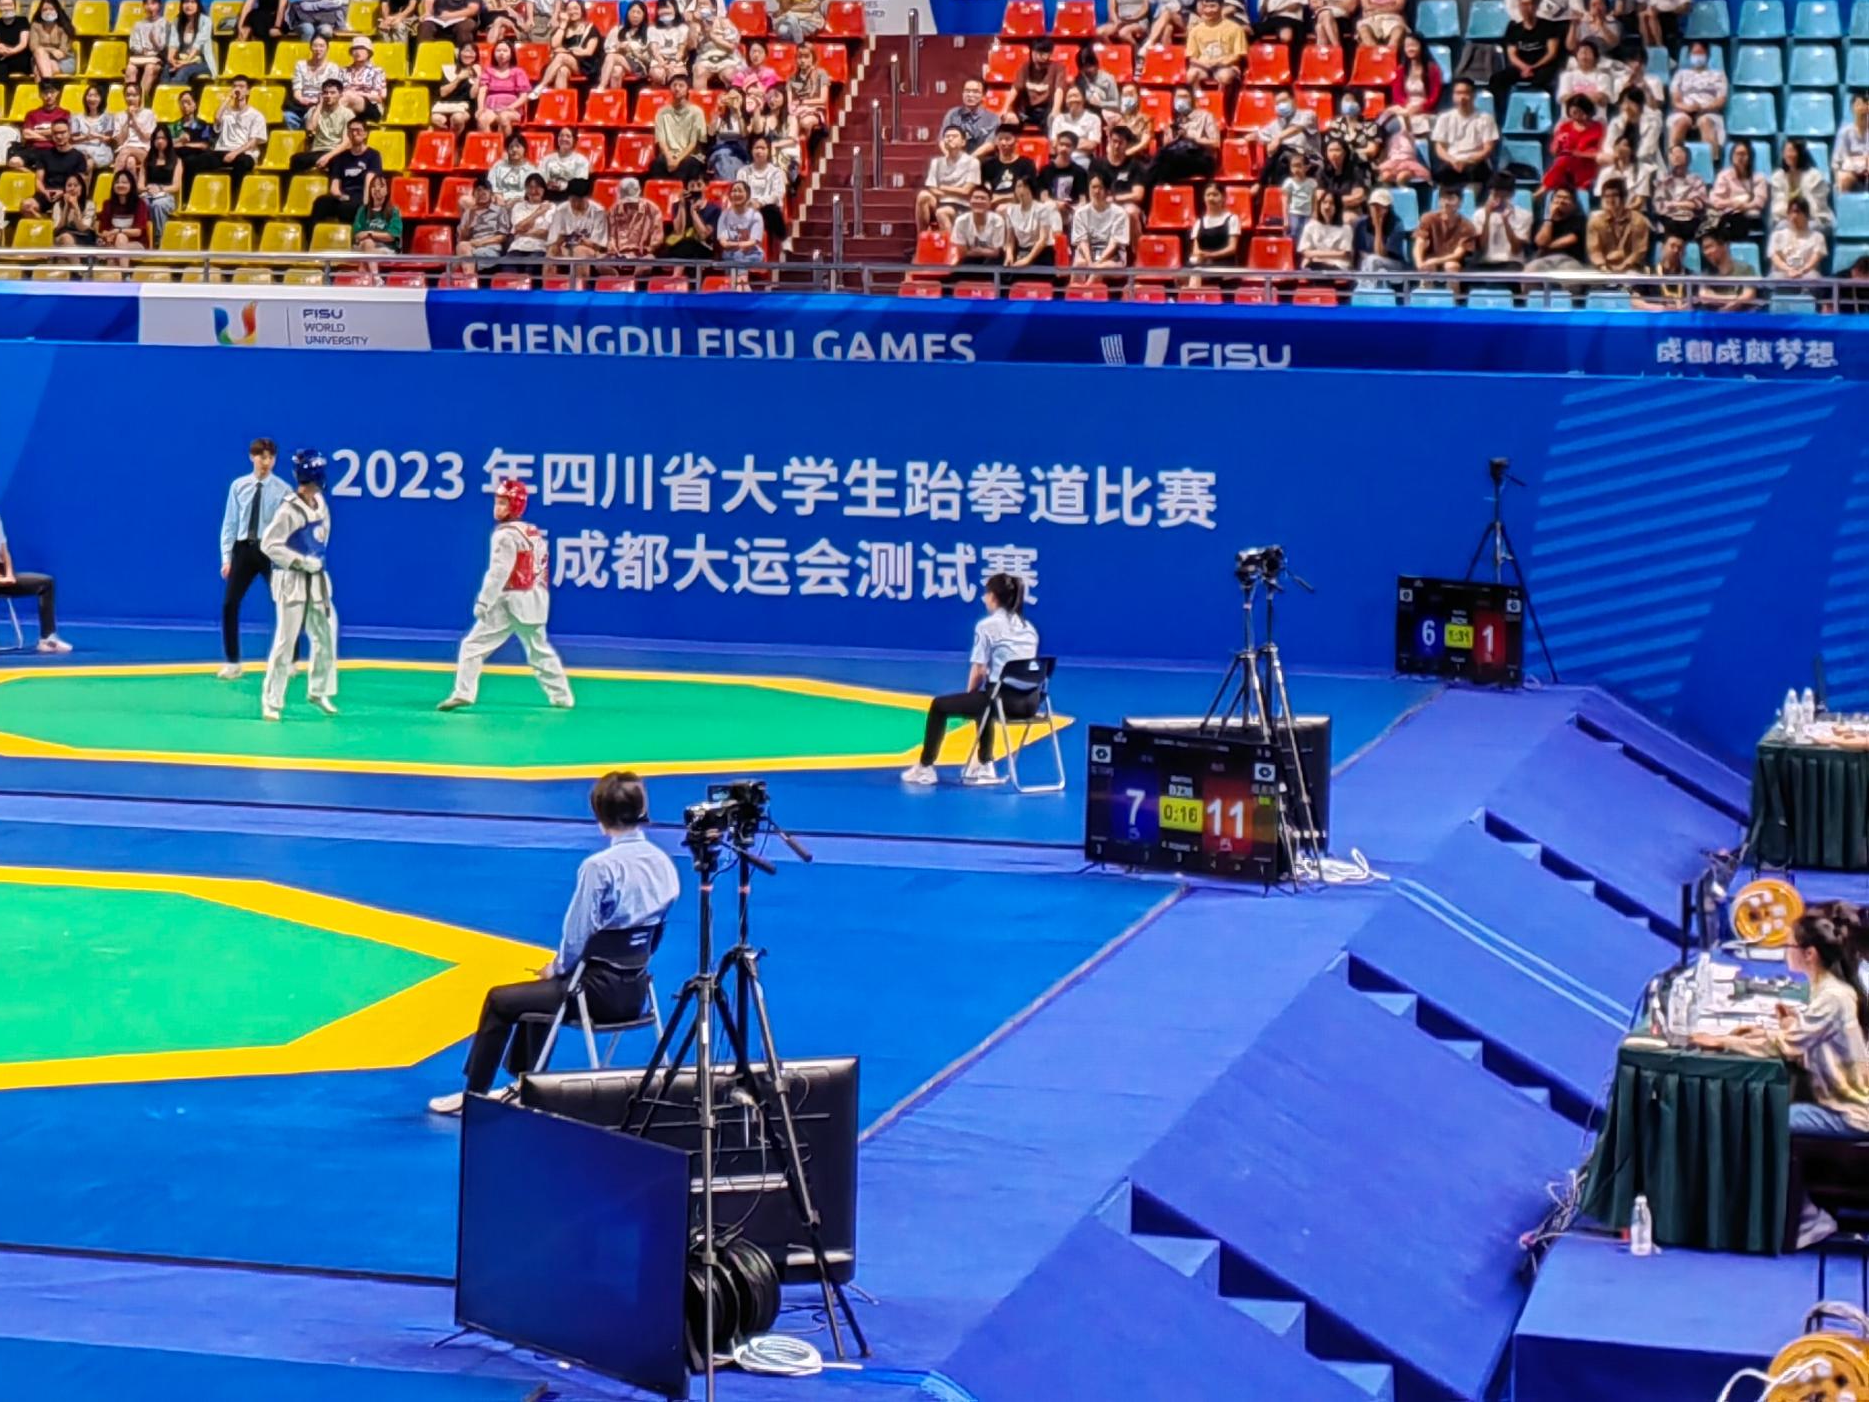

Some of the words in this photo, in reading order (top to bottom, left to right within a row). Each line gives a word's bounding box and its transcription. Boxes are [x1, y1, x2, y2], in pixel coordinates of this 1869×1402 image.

[303, 309, 343, 319] FISU
[304, 322, 345, 333] WORLD
[305, 336, 369, 346] UNIVERSITY
[462, 322, 682, 358] CHENGDU
[697, 328, 795, 360] FISU
[812, 330, 976, 363] GAMES
[1180, 342, 1291, 371] FISU
[331, 448, 465, 500] 2023
[540, 528, 1039, 605] 成都大运会测试赛
[1422, 619, 1436, 647] 6
[1482, 624, 1494, 654] 1
[1126, 789, 1146, 826] 7
[1207, 797, 1245, 839] 11
